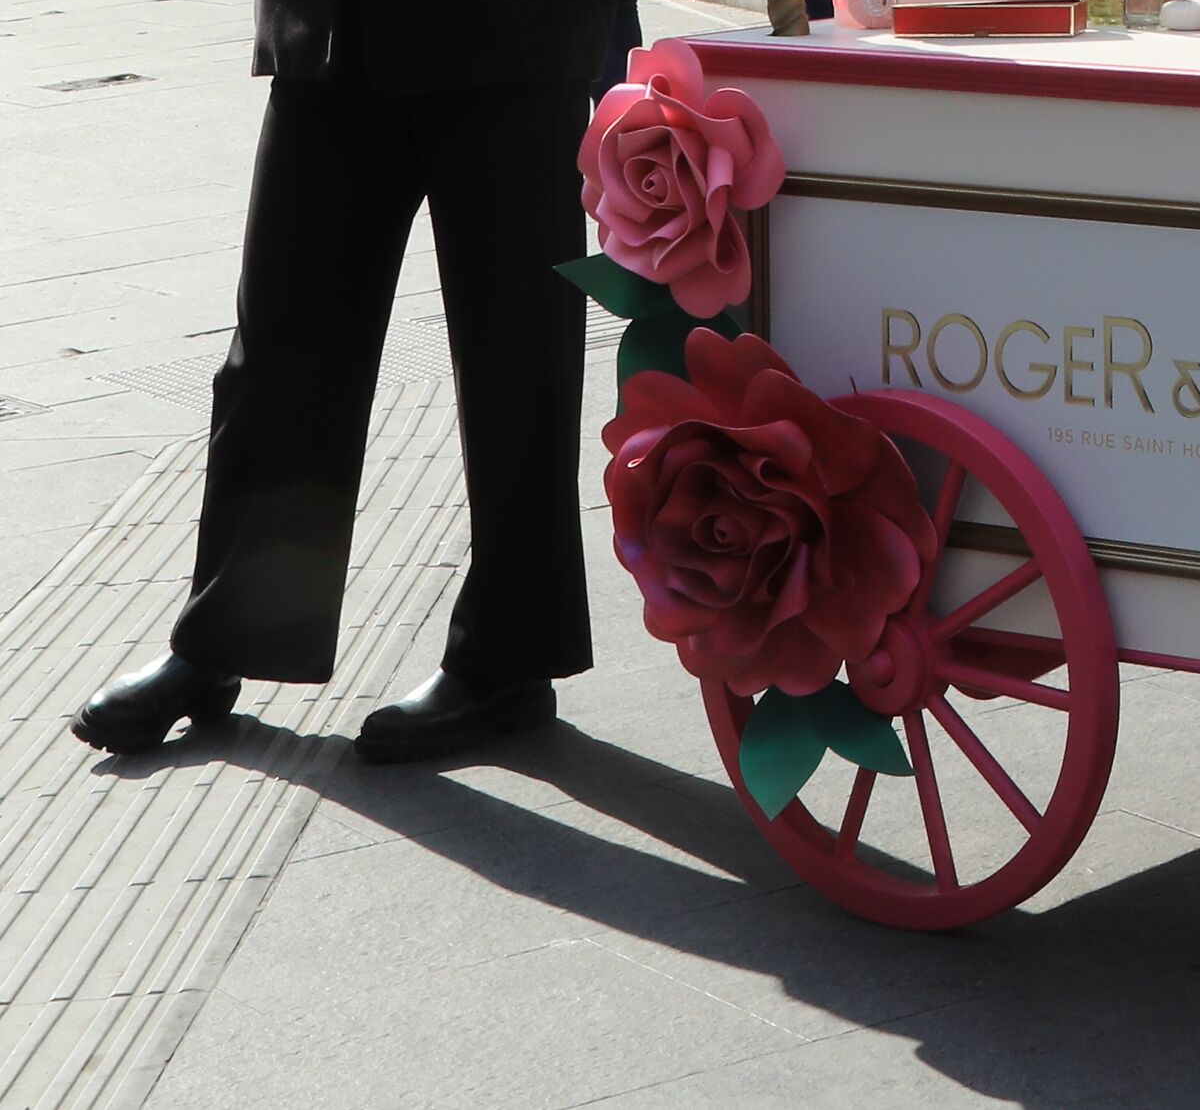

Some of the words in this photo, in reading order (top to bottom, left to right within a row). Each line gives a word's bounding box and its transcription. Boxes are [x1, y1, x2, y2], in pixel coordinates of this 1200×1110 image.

[881, 307, 1155, 414] ROGER
[1048, 427, 1075, 444] 195
[1081, 430, 1115, 449] RUE
[1122, 435, 1176, 456] SAINT
